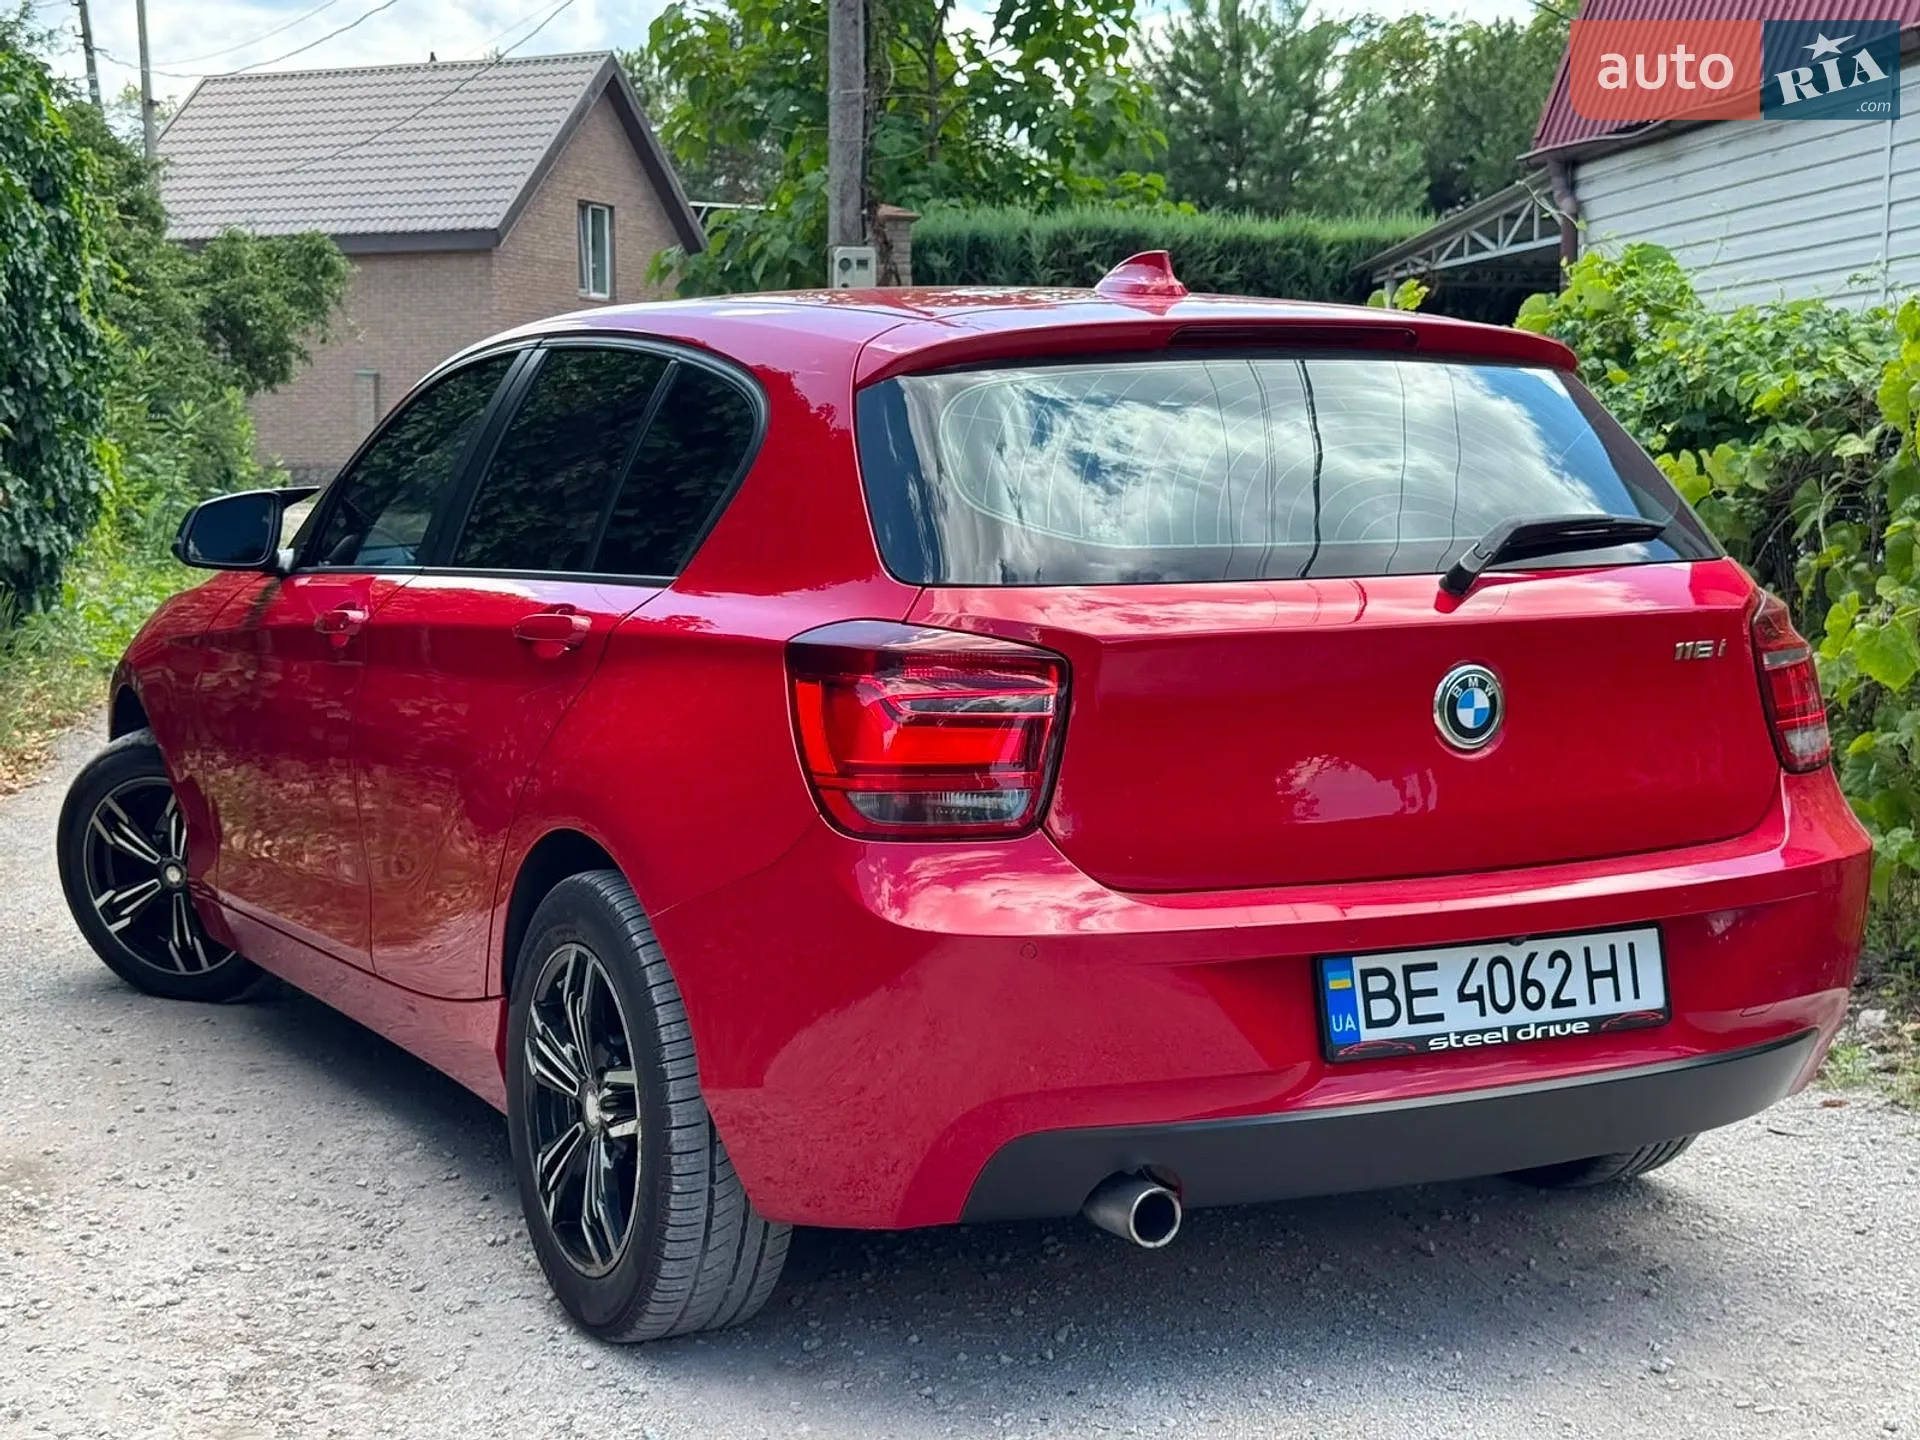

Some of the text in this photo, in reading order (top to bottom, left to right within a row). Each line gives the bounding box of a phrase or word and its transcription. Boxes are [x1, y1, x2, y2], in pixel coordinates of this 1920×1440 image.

[1451, 677, 1496, 698] BMW
[1360, 941, 1640, 1030] BE 4062 HI
[1331, 1013, 1357, 1033] UA
[1428, 1018, 1590, 1051] steel drive
